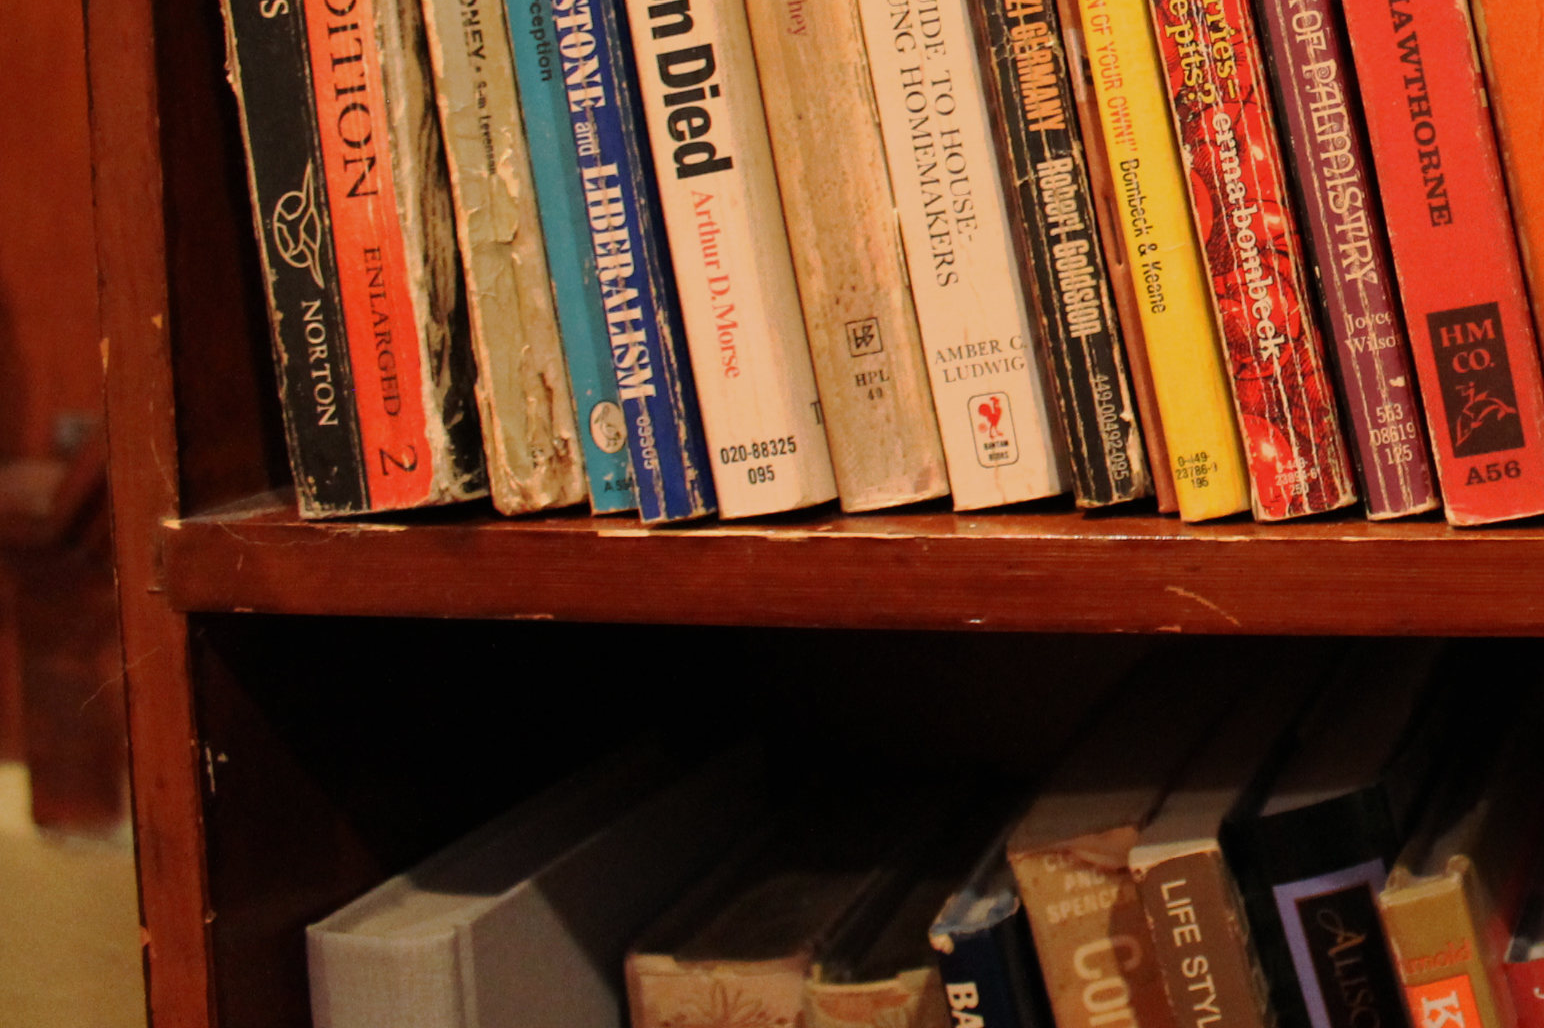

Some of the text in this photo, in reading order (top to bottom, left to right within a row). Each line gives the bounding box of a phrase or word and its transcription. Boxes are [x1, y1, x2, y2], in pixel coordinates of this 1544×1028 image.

[1089, 12, 1113, 40] OF
[1289, 7, 1328, 56] OF
[1008, 20, 1065, 135] GERMANY
[1094, 40, 1123, 92] YOUR
[1164, 21, 1216, 104] pits?
[653, 42, 733, 180] Died
[929, 69, 957, 118] TO
[572, 119, 599, 157] and
[899, 65, 958, 287] HOMEMAKERS
[939, 127, 978, 244] HOUSE-
[1299, 59, 1378, 290] PALMISTRY
[690, 187, 723, 271] Arthur
[1035, 156, 1104, 338] Robert Goldston
[1119, 157, 1164, 316] Bombeck Keane
[1208, 110, 1286, 362] erma bombeck
[579, 161, 656, 403] LIBERALISM
[362, 245, 403, 418] ENLARGED
[934, 339, 1003, 365] AMBER
[1440, 319, 1496, 347] HM
[1452, 348, 1495, 373] CO.
[300, 299, 338, 427] NORTON
[855, 369, 890, 387] HPL
[942, 356, 1025, 383] LUDWIG
[378, 442, 419, 477] 2
[720, 436, 797, 464] 020-88325
[748, 465, 775, 484] 095
[1465, 460, 1522, 486] A56
[1161, 879, 1202, 948] LIFE
